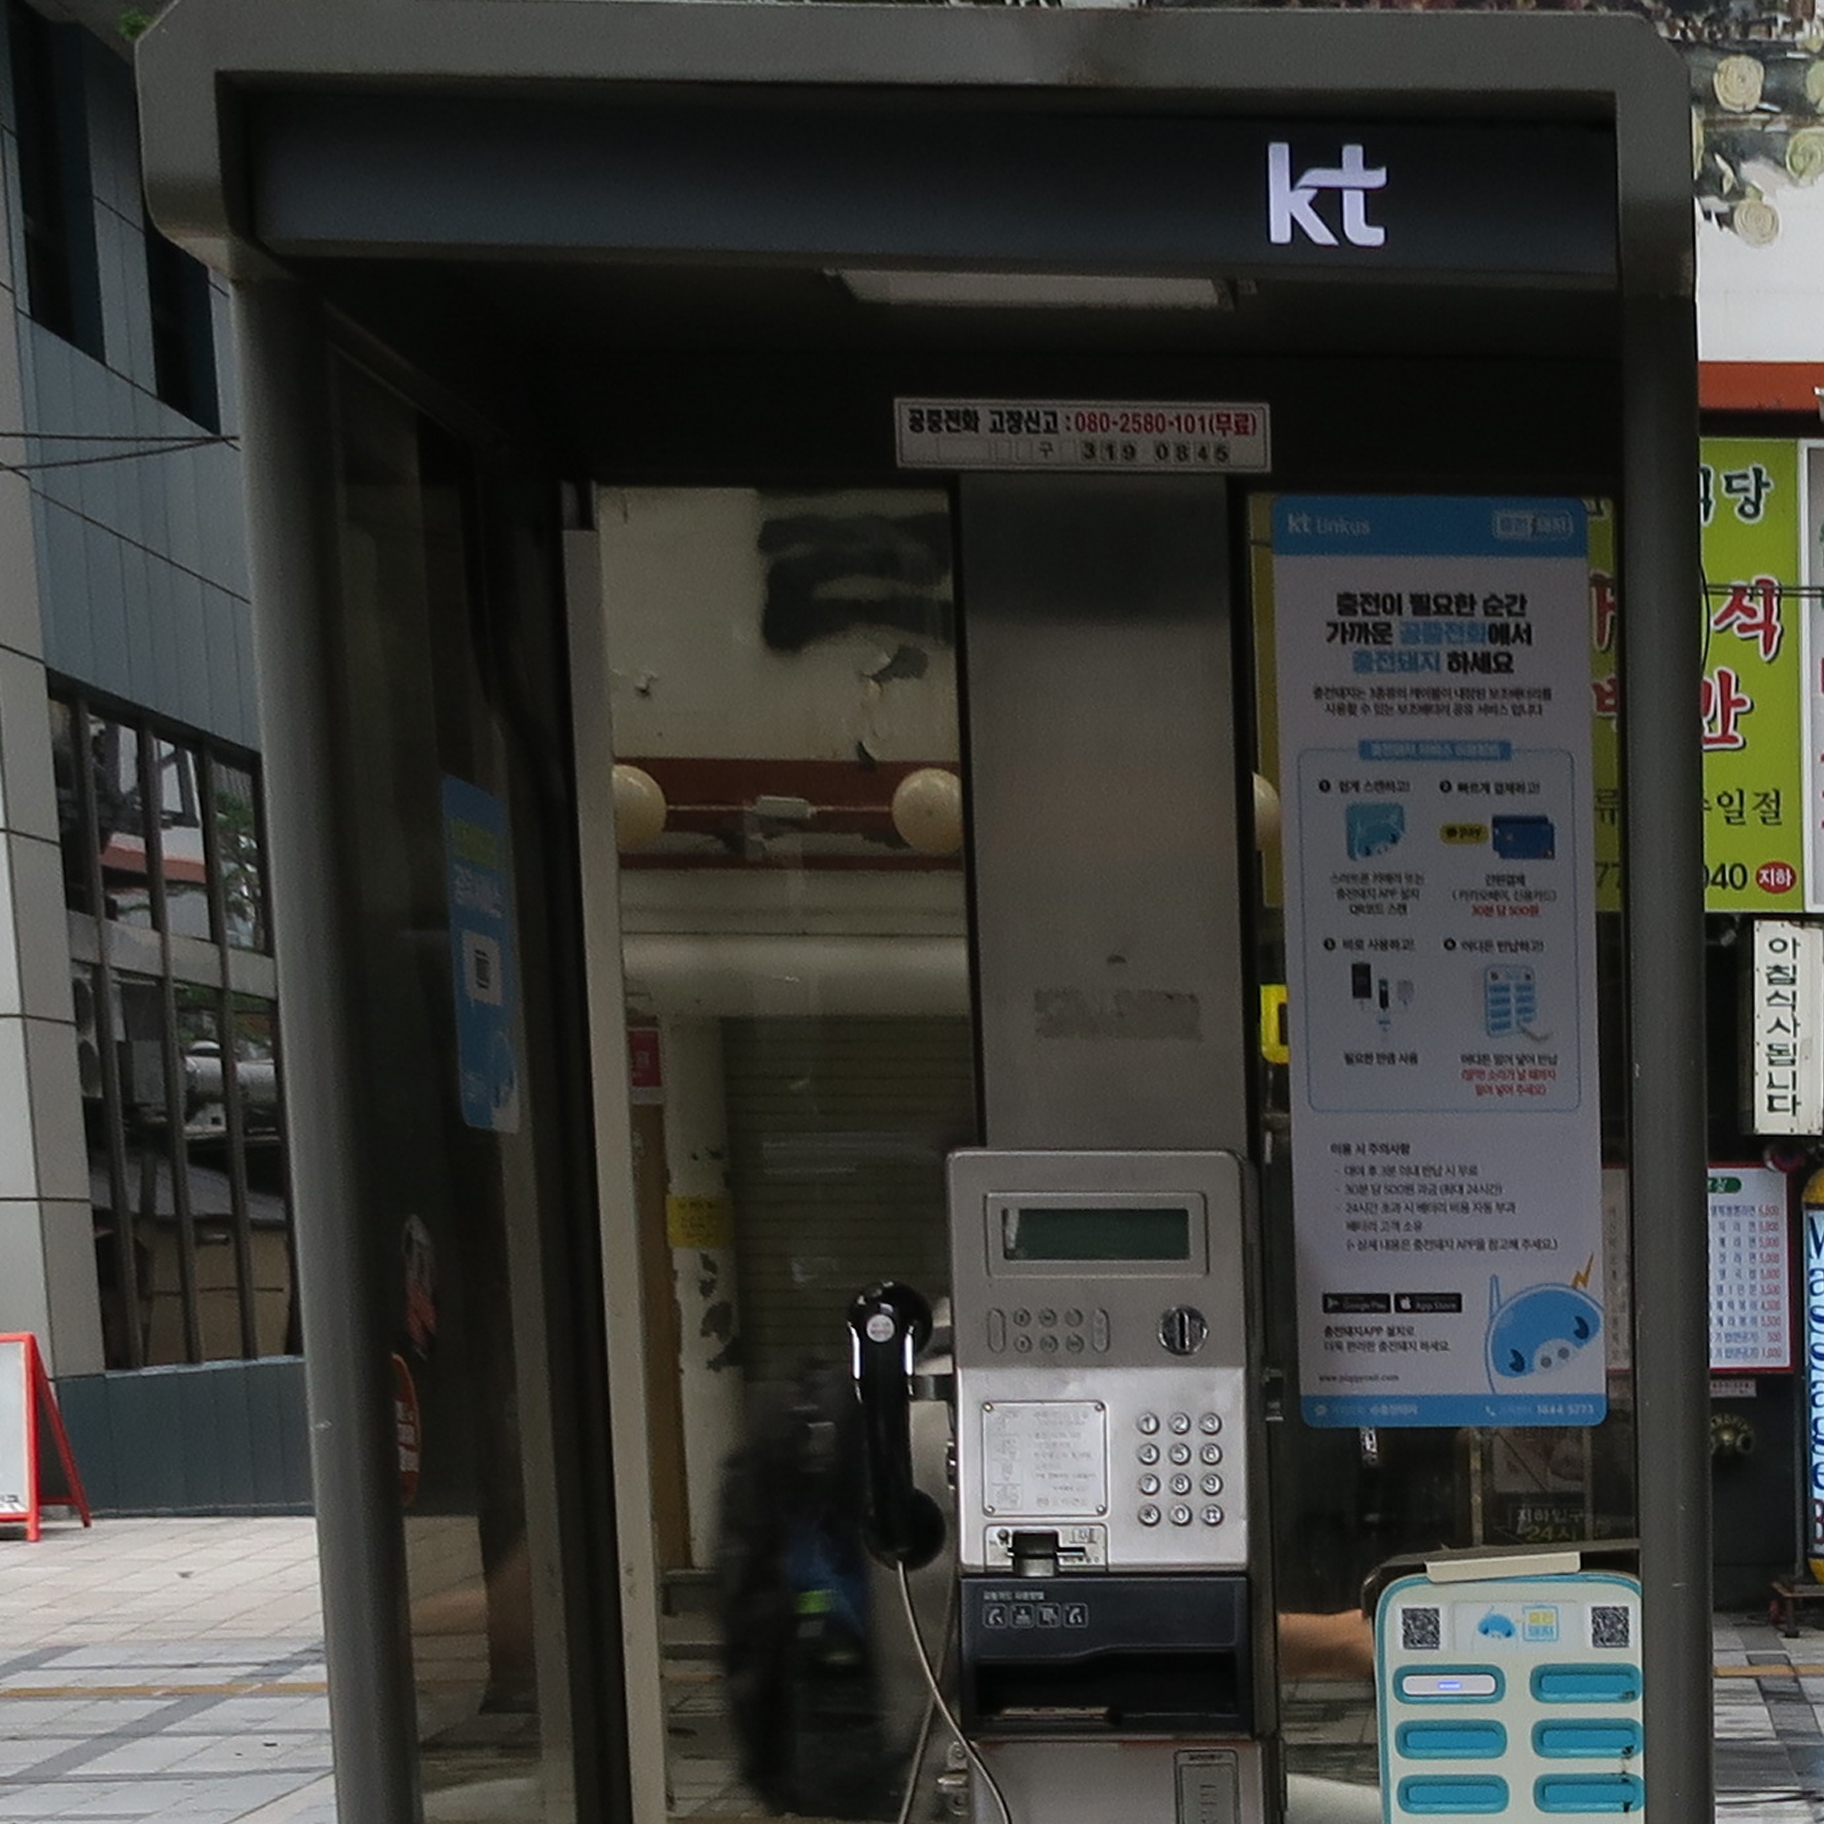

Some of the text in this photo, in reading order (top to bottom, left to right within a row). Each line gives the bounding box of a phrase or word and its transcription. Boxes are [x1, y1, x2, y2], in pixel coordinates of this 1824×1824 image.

[1268, 144, 1387, 246] kt
[909, 409, 980, 434] 공중전화
[989, 409, 1060, 434] 고장신고
[1288, 513, 1311, 535] kt
[1337, 593, 1528, 618] 충전이 필요한 순간
[1326, 621, 1393, 646] 가까운
[1447, 651, 1515, 675] 하세요
[1758, 868, 1794, 888] 지하
[1766, 937, 1801, 1117] 아침식사됩니다
